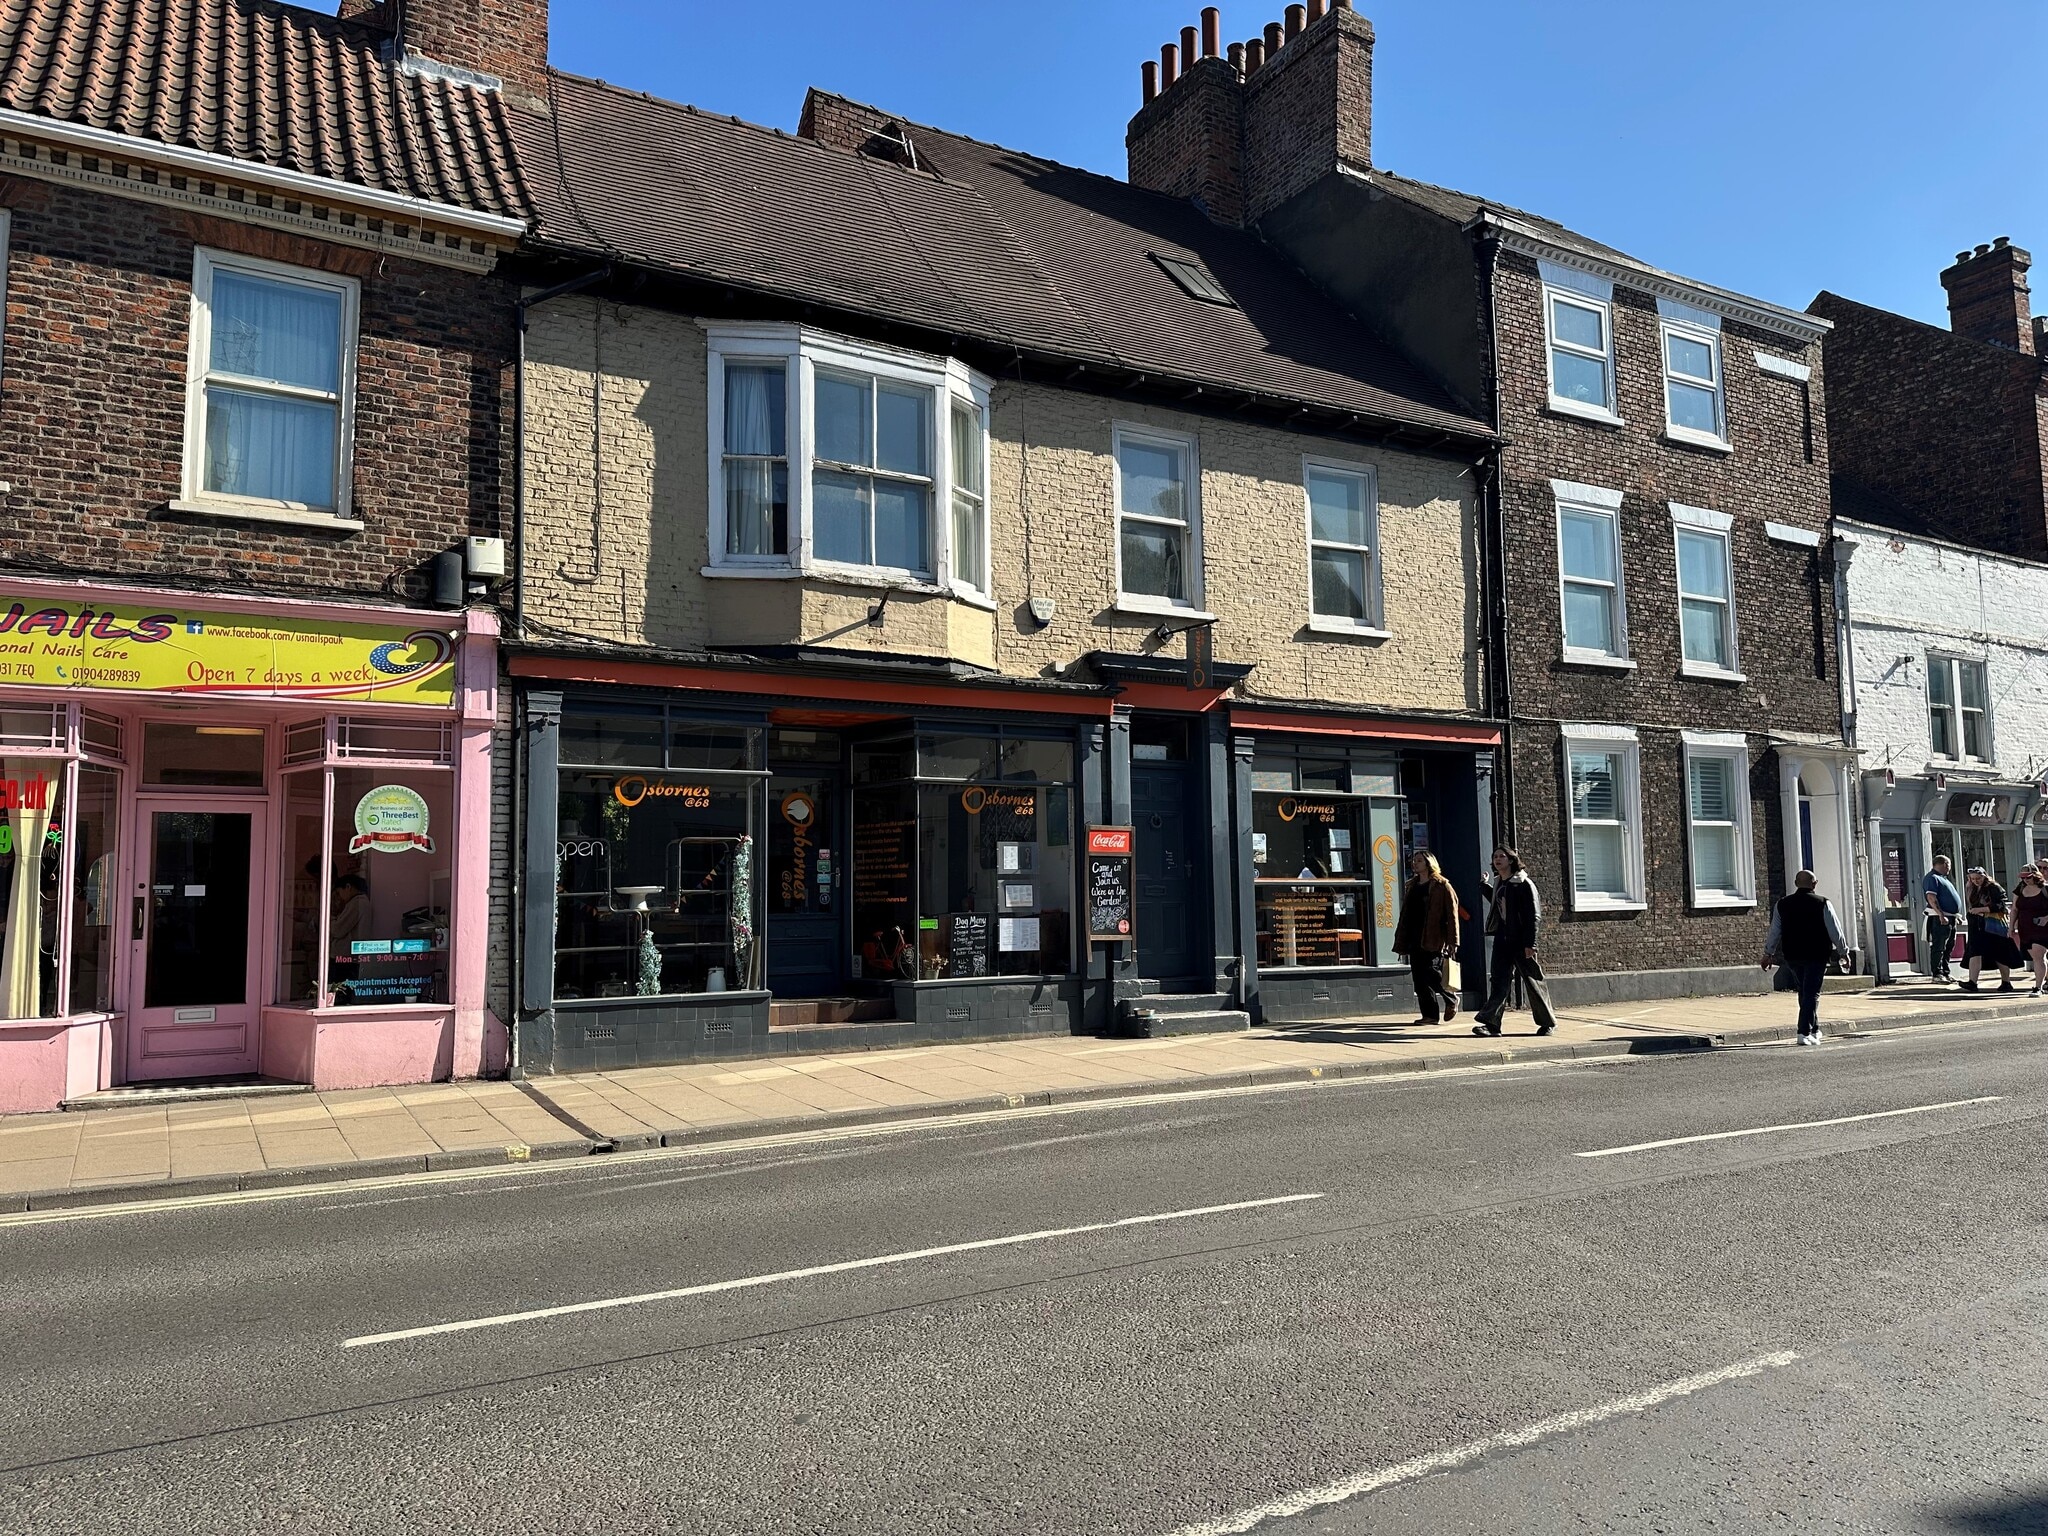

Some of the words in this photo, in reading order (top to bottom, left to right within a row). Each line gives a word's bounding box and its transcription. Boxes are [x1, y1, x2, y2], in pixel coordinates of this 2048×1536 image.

[207, 625, 344, 646] www.facebook.com/usnailspauk
[42, 643, 83, 657] Nails
[92, 646, 129, 660] Care
[16, 664, 35, 679] 7EQ
[72, 667, 141, 683] 01904289839
[187, 660, 235, 685] Open
[245, 667, 255, 683] 7
[264, 667, 302, 687] days
[311, 671, 321, 683] a
[614, 775, 710, 807] Osbornes
[684, 797, 710, 808] @68
[962, 786, 1034, 815] Osbornes
[1015, 806, 1034, 815] @68
[1278, 797, 1335, 822] Osbornes
[1969, 797, 1996, 818] cut
[381, 811, 419, 819] ThreeBest
[1320, 814, 1335, 822] @68
[1889, 850, 1899, 858] cut
[1092, 862, 1110, 873] Come
[1113, 861, 1121, 872] in
[1101, 868, 1113, 878] and
[1095, 876, 1111, 887] Join
[1372, 835, 1398, 929] Osbornes
[1116, 885, 1127, 896] the
[955, 917, 969, 928] Dog
[970, 915, 987, 927] Menu
[335, 955, 353, 963] Mon
[358, 955, 371, 963] Sat
[376, 954, 393, 962] 9:00
[344, 978, 398, 988] Appointments
[398, 976, 432, 985] Accepted
[354, 987, 373, 996] Walk
[388, 986, 422, 996] Welcome
